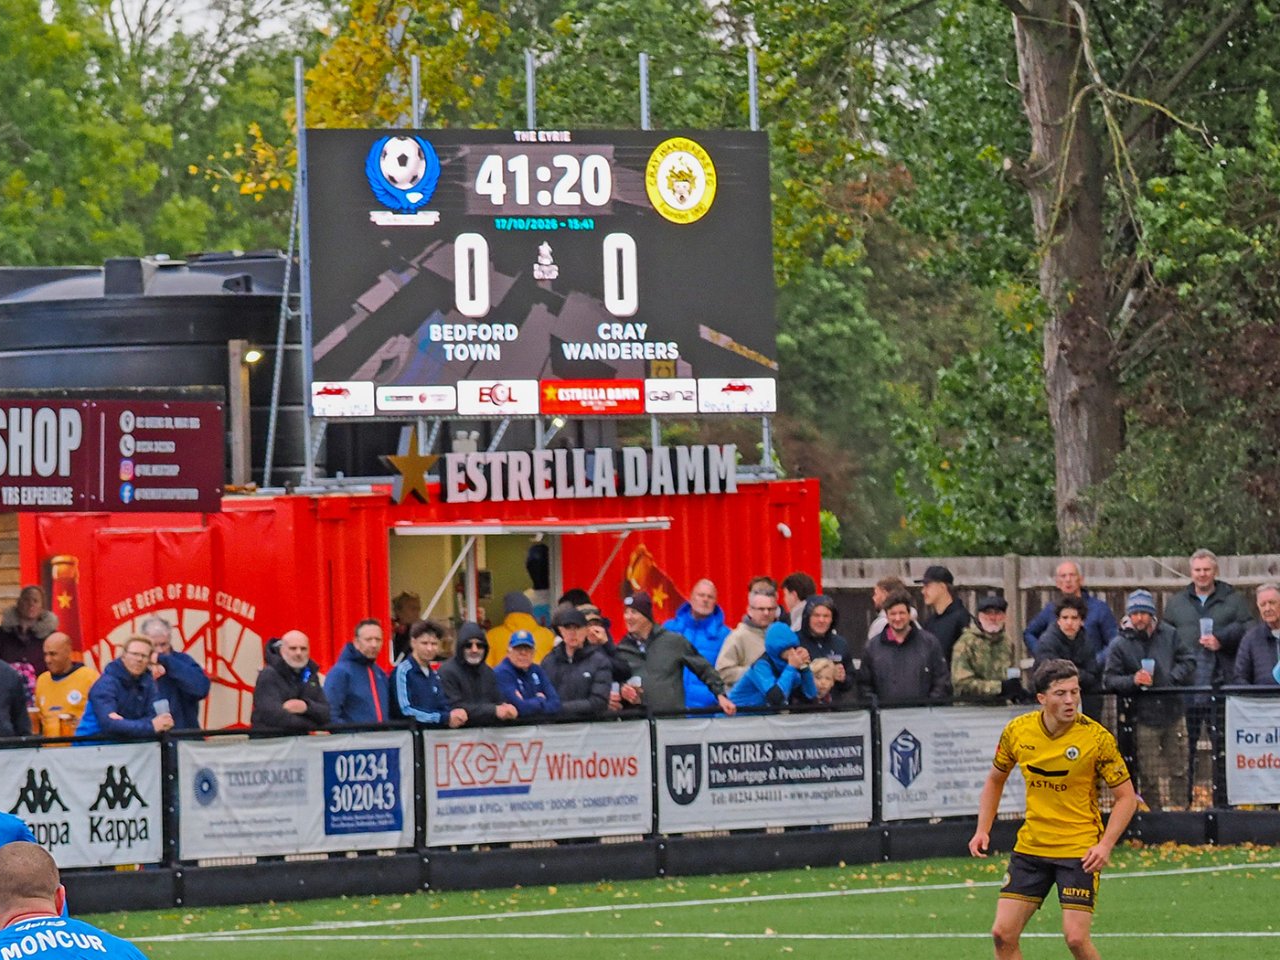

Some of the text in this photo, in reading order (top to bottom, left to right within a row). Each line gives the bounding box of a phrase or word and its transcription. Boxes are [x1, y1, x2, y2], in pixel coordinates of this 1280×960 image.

[515, 131, 537, 142] THE
[476, 154, 612, 206] 41:20
[454, 233, 490, 317] 0
[603, 233, 638, 317] 0
[430, 323, 519, 342] BEDFORD
[598, 323, 648, 340] CRAY
[443, 343, 501, 361] TOWN
[562, 342, 679, 360] WANDERERS
[558, 387, 640, 401] ESTRELLA DAMM
[445, 443, 739, 503] ESTRELLA DAMM
[20, 486, 74, 506] EXPERIENCE
[111, 597, 135, 620] THE
[166, 583, 183, 600] OF
[1236, 729, 1261, 744] For
[434, 740, 639, 788] KCW Windows
[710, 743, 862, 765] McGIRLS MONEY MANAGEMENT
[335, 753, 389, 783] 01234
[711, 762, 863, 784] The Mortgage & Protection Specialists
[329, 782, 396, 814] 302043
[510, 800, 545, 812] WINDOWS
[550, 797, 577, 810] DOORS
[711, 792, 726, 805] Tel:
[728, 791, 753, 804] 01234
[89, 816, 149, 849] Kappa
